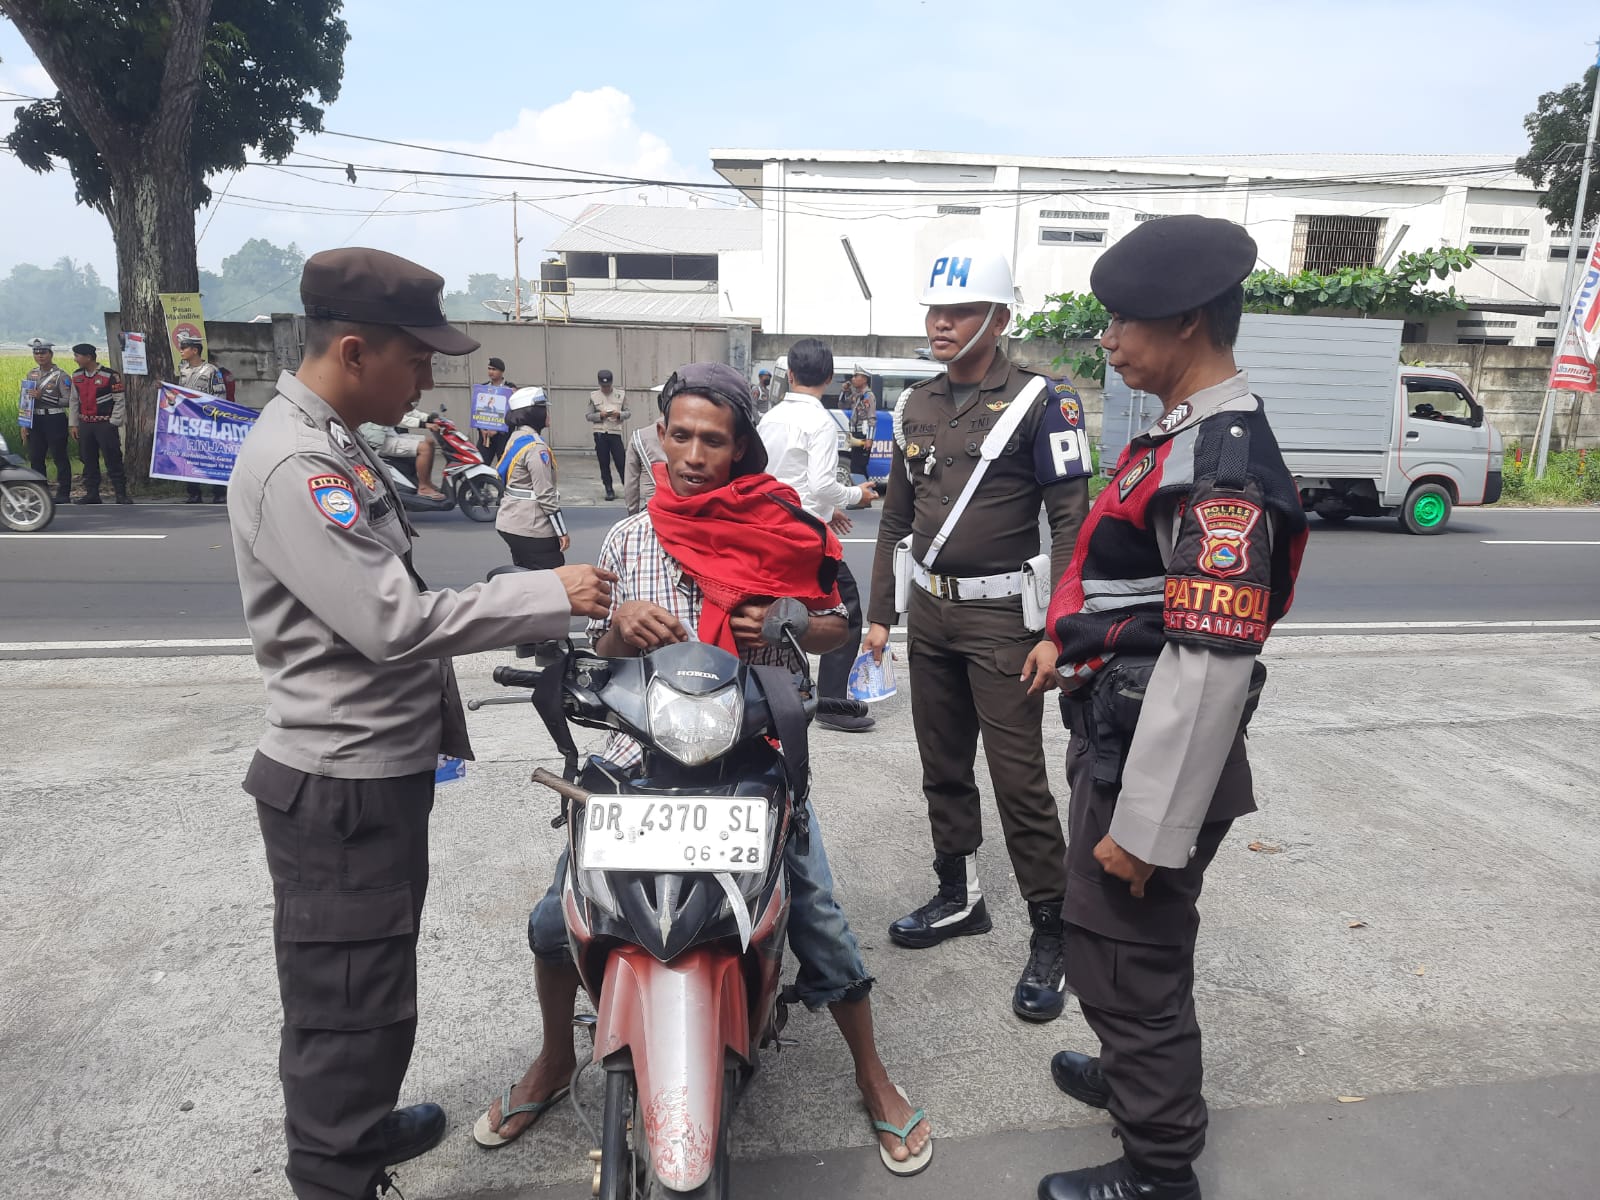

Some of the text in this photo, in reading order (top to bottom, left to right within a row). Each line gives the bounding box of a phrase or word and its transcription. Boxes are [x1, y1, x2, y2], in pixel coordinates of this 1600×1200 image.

[930, 256, 972, 288] PM
[970, 417, 990, 428] TNI
[1204, 506, 1251, 517] POLRES
[1165, 578, 1270, 622] PATROLI
[677, 670, 720, 681] HONDA
[590, 803, 759, 833] DR 4370 SL
[684, 845, 760, 863] 06 28
